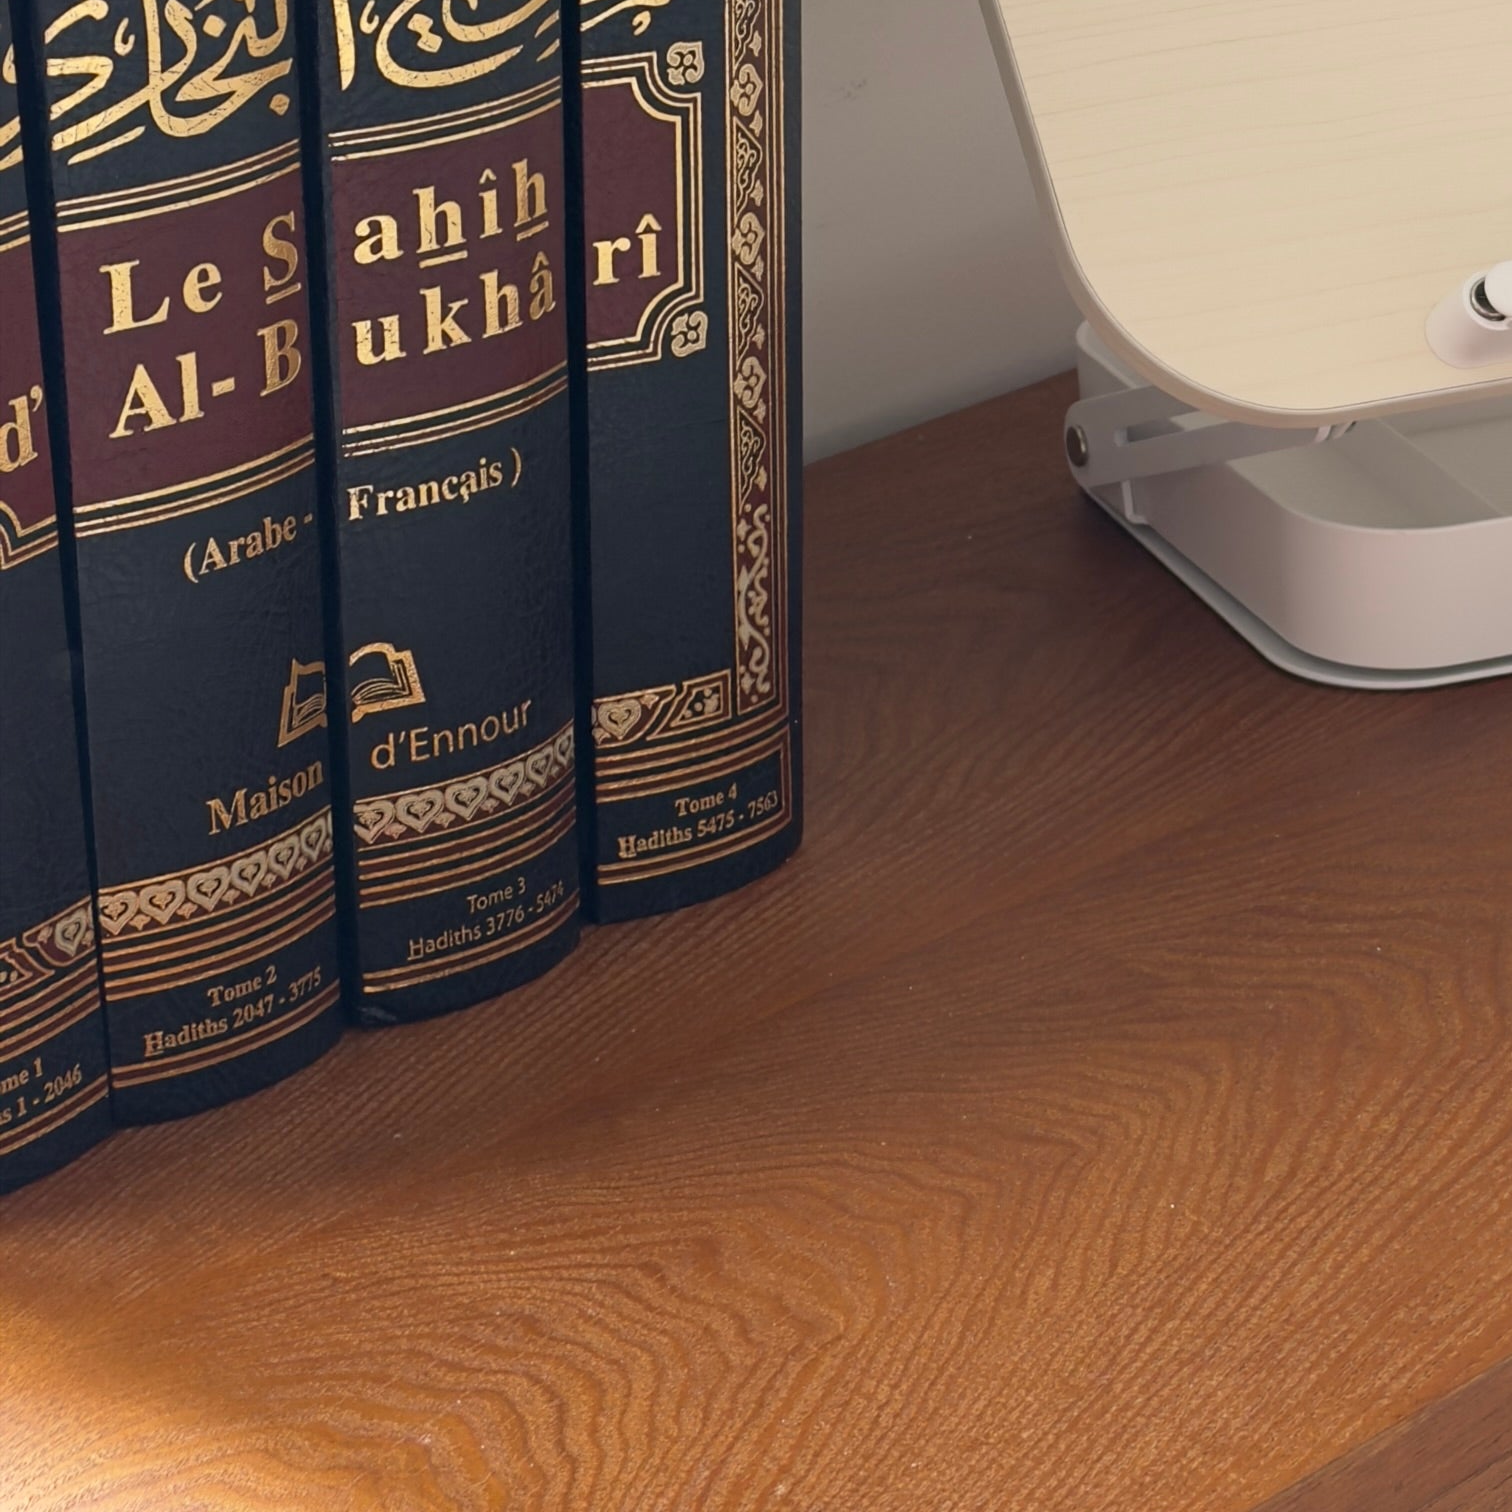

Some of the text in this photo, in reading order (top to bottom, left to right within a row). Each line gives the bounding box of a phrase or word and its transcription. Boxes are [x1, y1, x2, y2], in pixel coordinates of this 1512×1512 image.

[100, 256, 222, 335] Le
[370, 698, 532, 770] d'Ennour
[206, 760, 324, 836] Maison
[617, 826, 693, 859] Hadiths
[697, 809, 734, 837] 5475
[747, 790, 778, 818] 7563
[674, 782, 737, 817] Tome 4
[467, 876, 526, 914] Tome 3
[407, 923, 482, 961] Hadiths
[486, 905, 525, 937] 3776
[144, 1017, 228, 1057] Hadiths
[232, 996, 274, 1029] 2047
[290, 965, 322, 1003] 3775
[207, 965, 278, 1008] Tome 2
[44, 1063, 82, 1104] 2046
